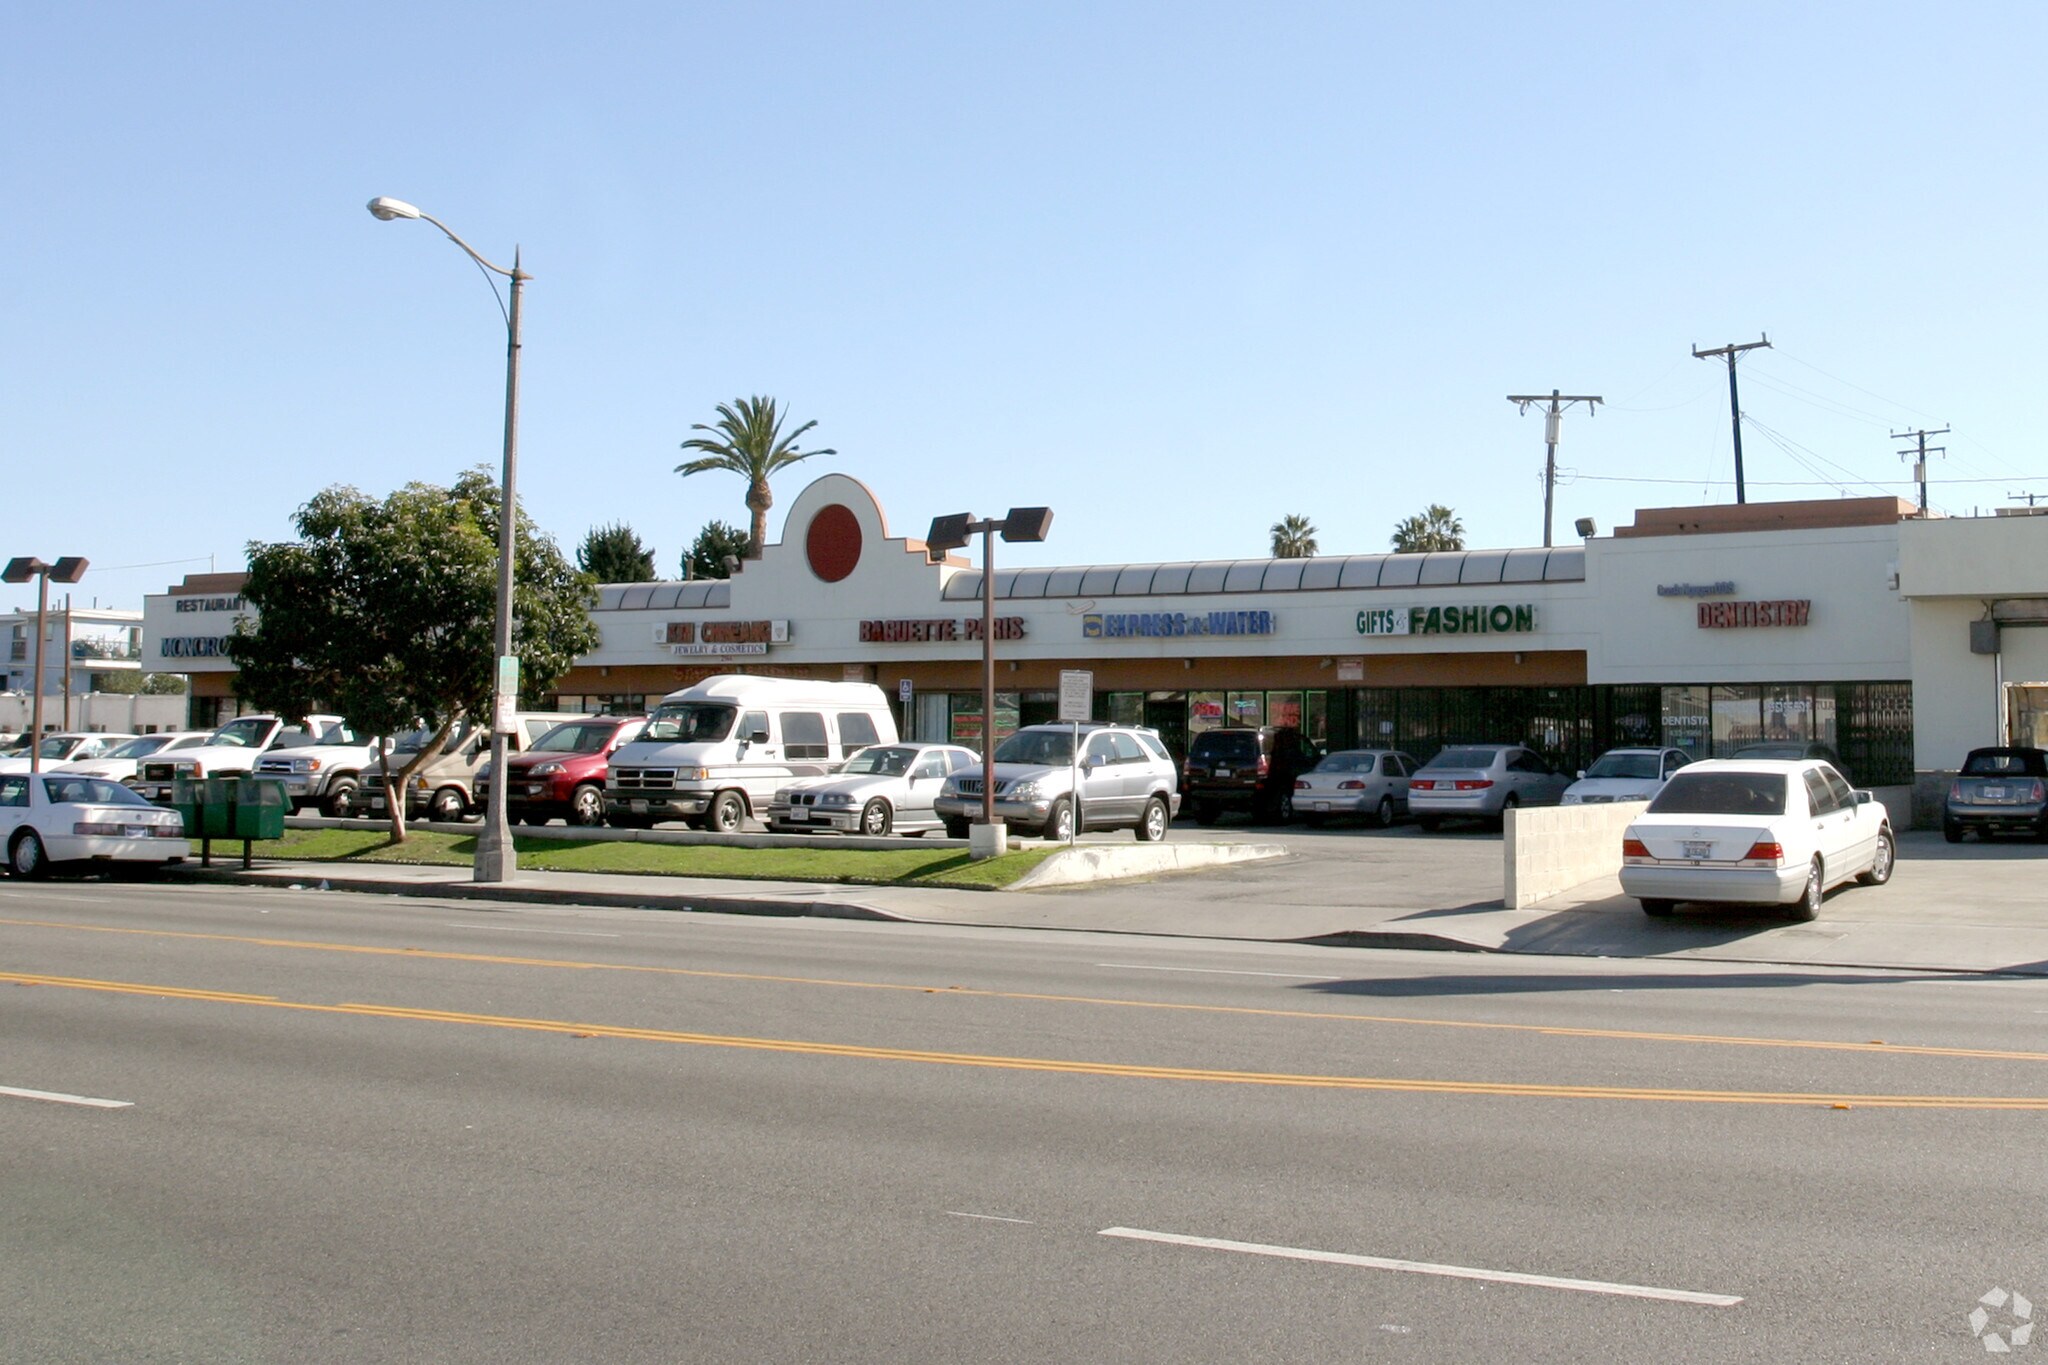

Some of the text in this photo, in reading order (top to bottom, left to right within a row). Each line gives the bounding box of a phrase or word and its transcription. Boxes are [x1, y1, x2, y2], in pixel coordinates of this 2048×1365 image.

[176, 598, 246, 612] RESTAURANT
[1697, 599, 1811, 629] DENTISTRY
[859, 616, 1025, 642] BAGUETTE PARIS
[1105, 611, 1272, 637] EXPRESS & WATER
[1356, 609, 1394, 634] GIFTS
[1409, 604, 1533, 634] FASHION
[674, 644, 708, 654] JEWELRY
[720, 643, 765, 654] COSMETICS
[1662, 715, 1710, 726] DENTISTA
